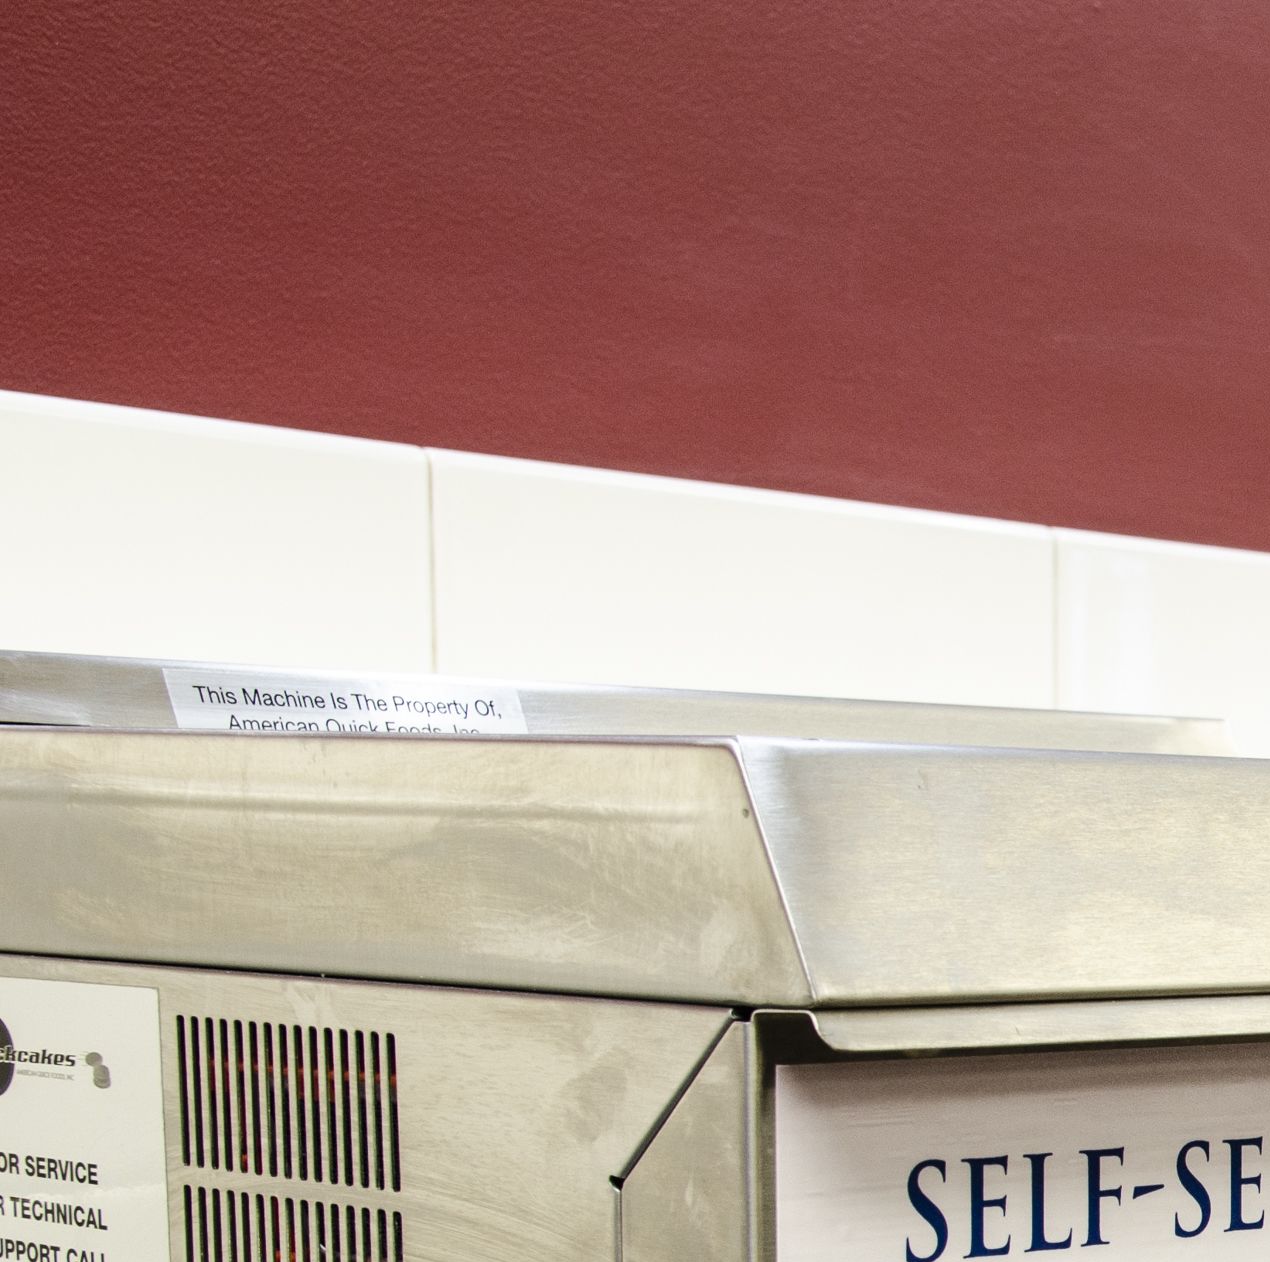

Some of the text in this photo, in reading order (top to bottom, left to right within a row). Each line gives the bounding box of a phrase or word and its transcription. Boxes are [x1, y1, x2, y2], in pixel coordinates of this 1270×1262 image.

[192, 685, 502, 719] This Machine Is The Property Of,
[25, 1155, 98, 1185] SERVICE
[10, 1196, 108, 1231] TECHNICAL
